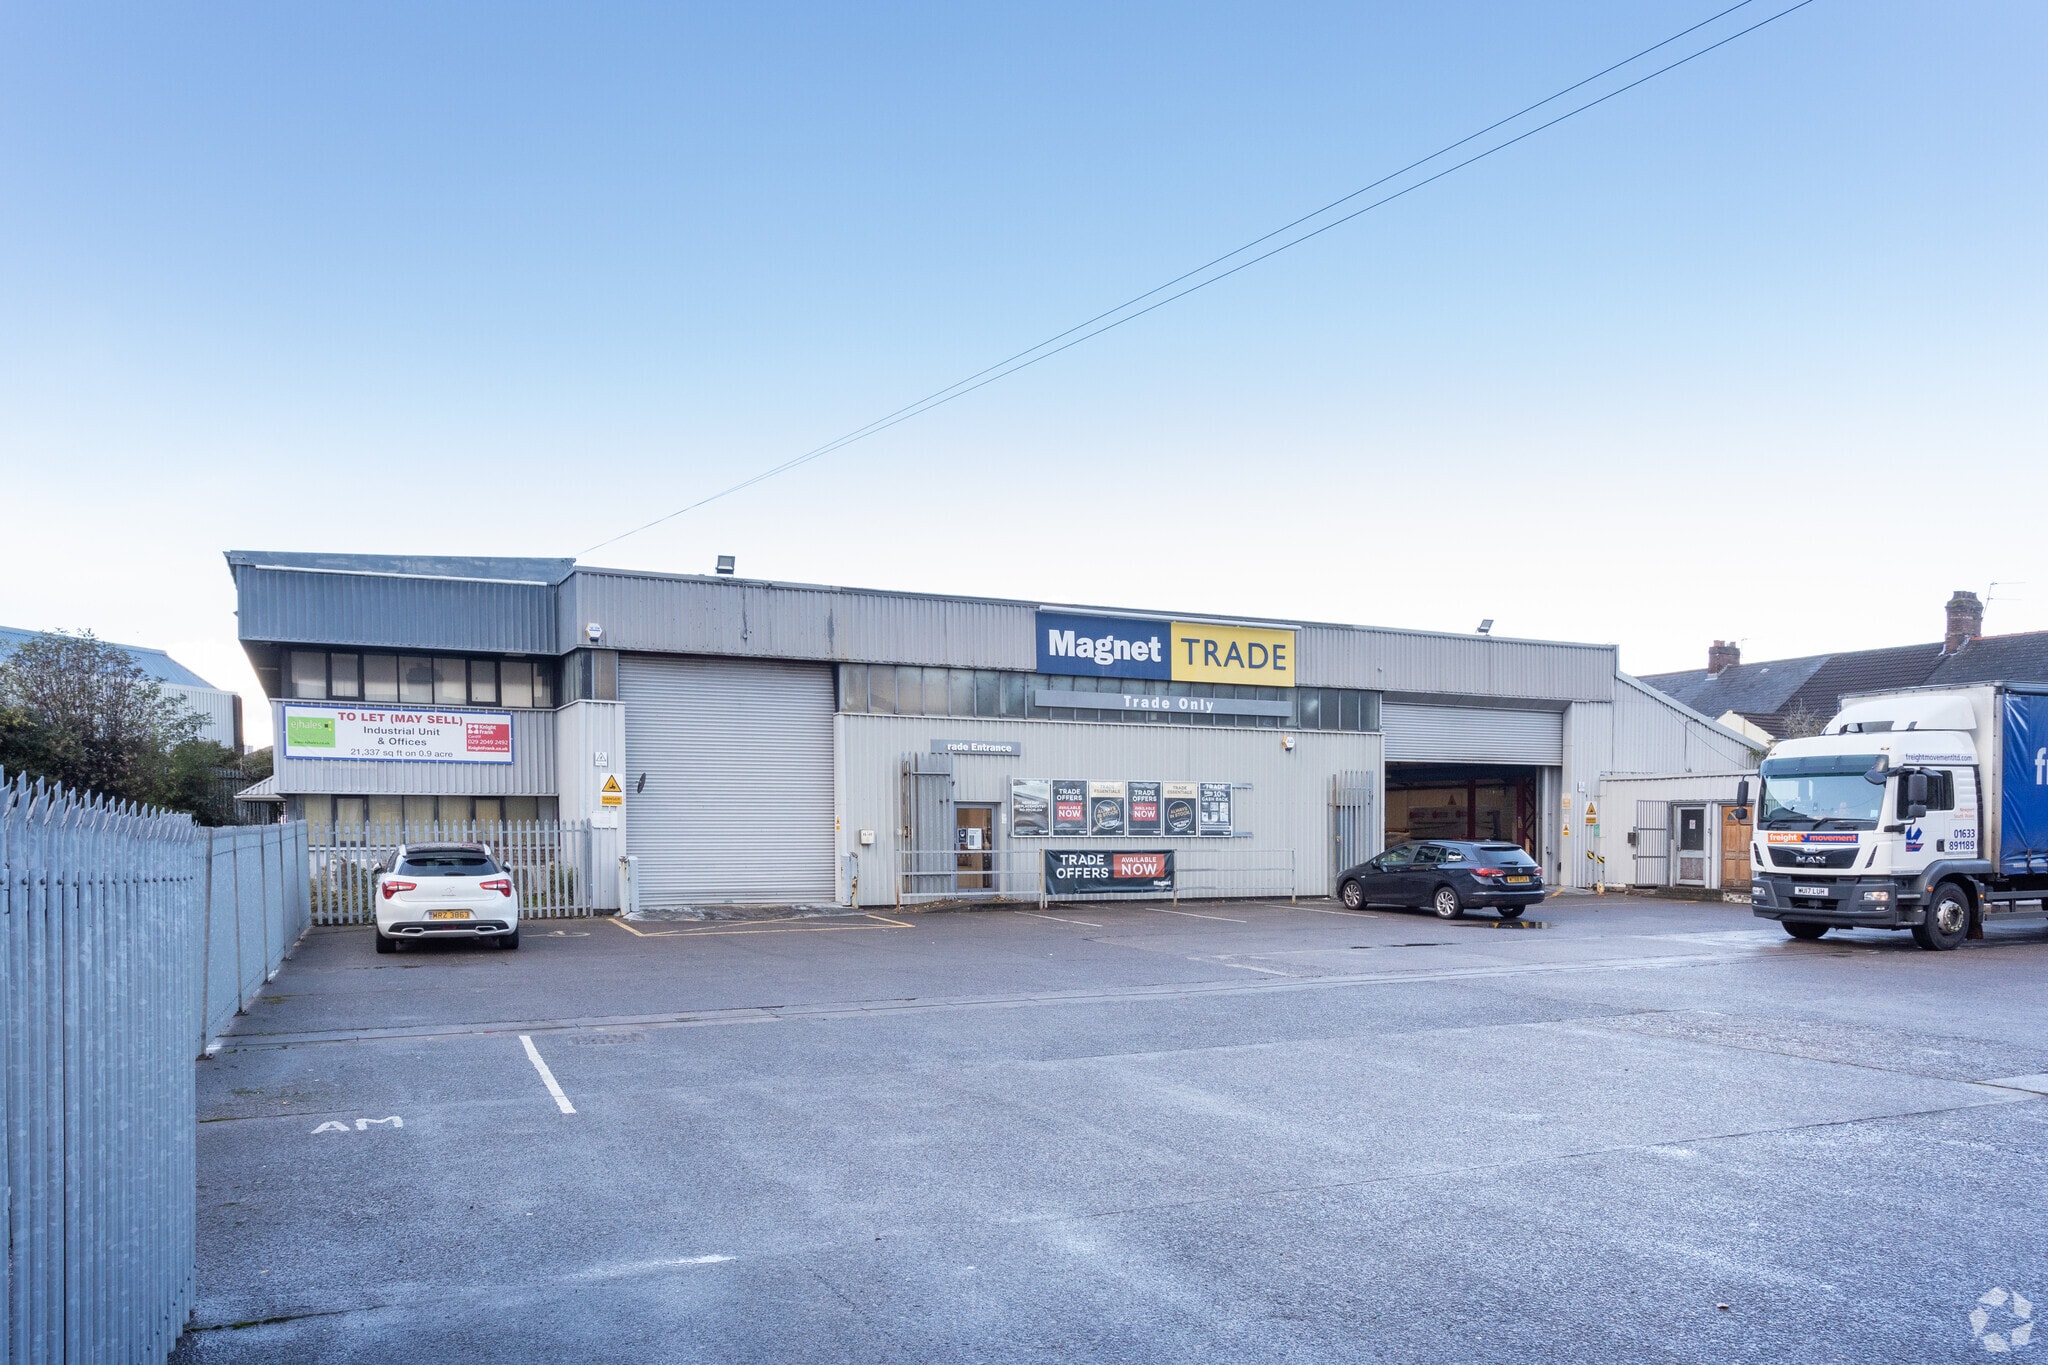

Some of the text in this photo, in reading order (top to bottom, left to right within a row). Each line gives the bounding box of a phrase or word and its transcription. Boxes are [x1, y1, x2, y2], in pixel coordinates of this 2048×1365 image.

[1048, 629, 1162, 666] Magnet
[1180, 637, 1287, 671] TRADE
[1123, 695, 1214, 713] Trade Only
[290, 719, 323, 730] ejhales
[338, 712, 463, 726] TO LET (MAY SELL)
[363, 726, 441, 736] Industrial Unit
[377, 737, 427, 746] & Offices
[947, 742, 1012, 752] rade Entrance
[350, 748, 381, 757] 21,337
[383, 750, 394, 758] sq
[396, 749, 403, 757] ft
[1905, 750, 1973, 762] freightmovementltd.com
[1134, 810, 1156, 818] NOW
[1769, 833, 1857, 843] freight movement
[1953, 829, 1976, 839] 01633
[1949, 840, 1976, 851] 891189
[1060, 854, 1105, 865] TRADE
[1795, 856, 1826, 864] MAN
[1056, 867, 1109, 879] OFFERS
[1121, 863, 1158, 876] NOW
[310, 1115, 404, 1134] AM
